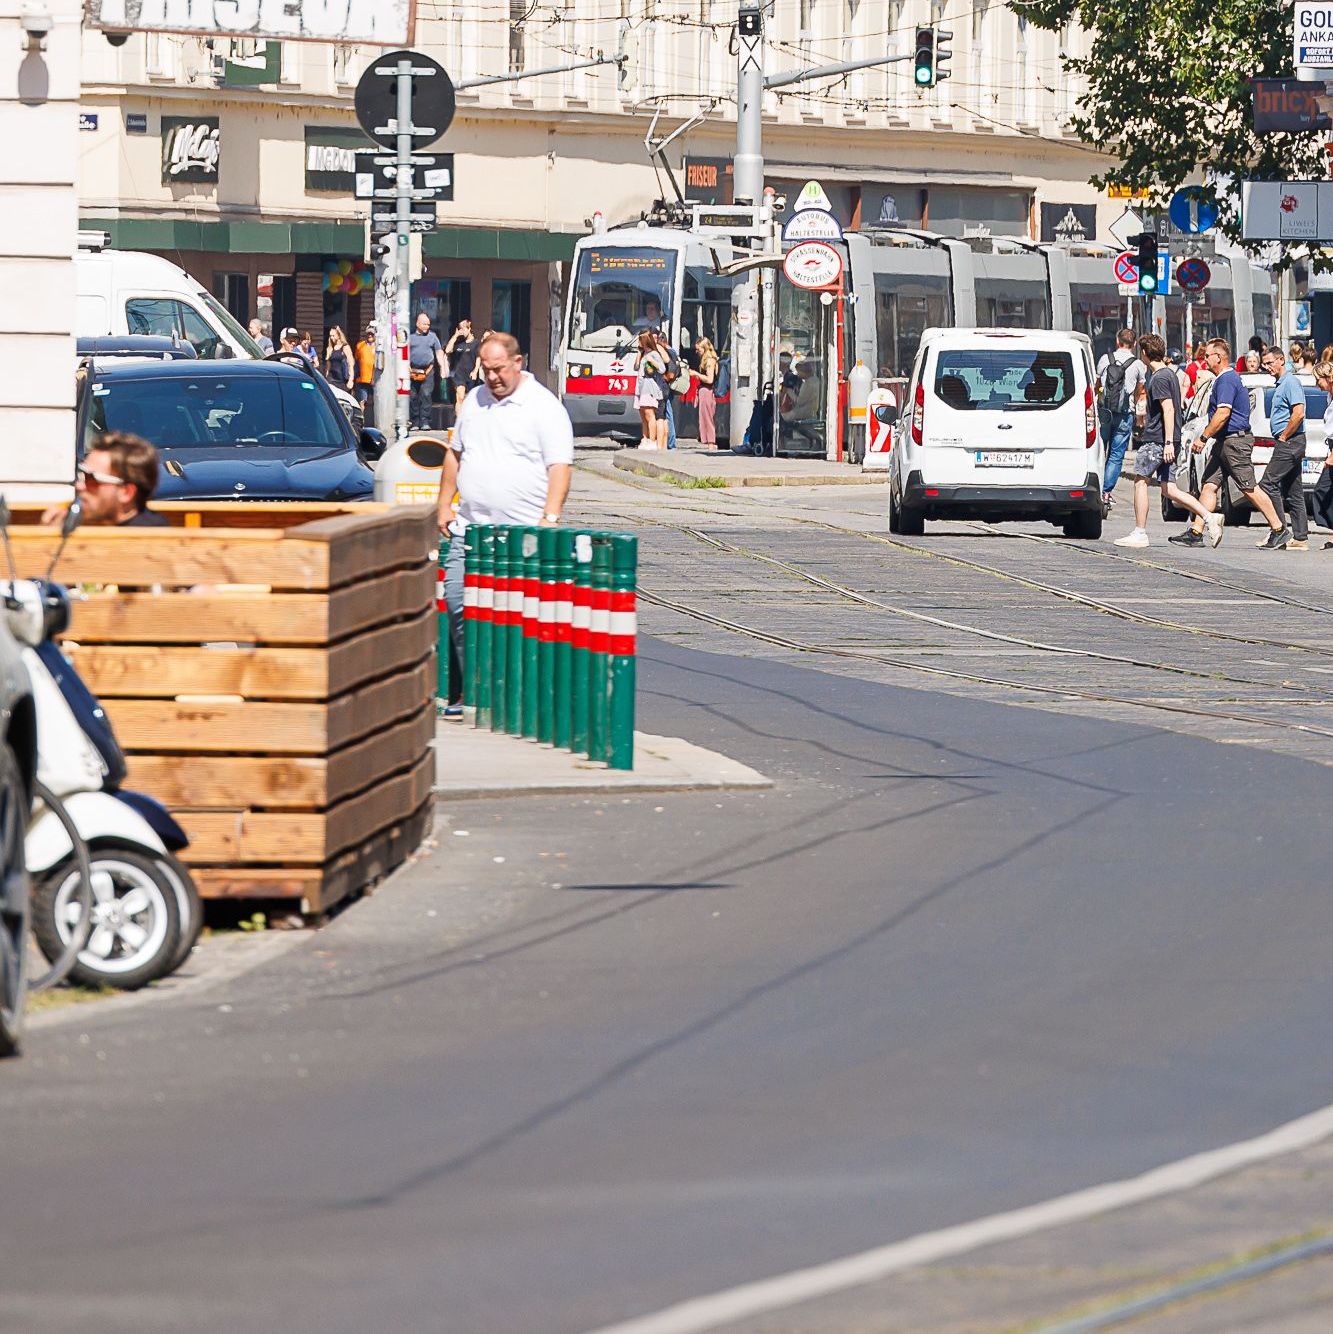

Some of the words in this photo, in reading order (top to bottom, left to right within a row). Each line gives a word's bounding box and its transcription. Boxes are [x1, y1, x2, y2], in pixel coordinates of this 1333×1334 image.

[688, 165, 717, 187] FRISEUR
[790, 228, 835, 237] HALTESTELLE
[608, 378, 629, 390] 743
